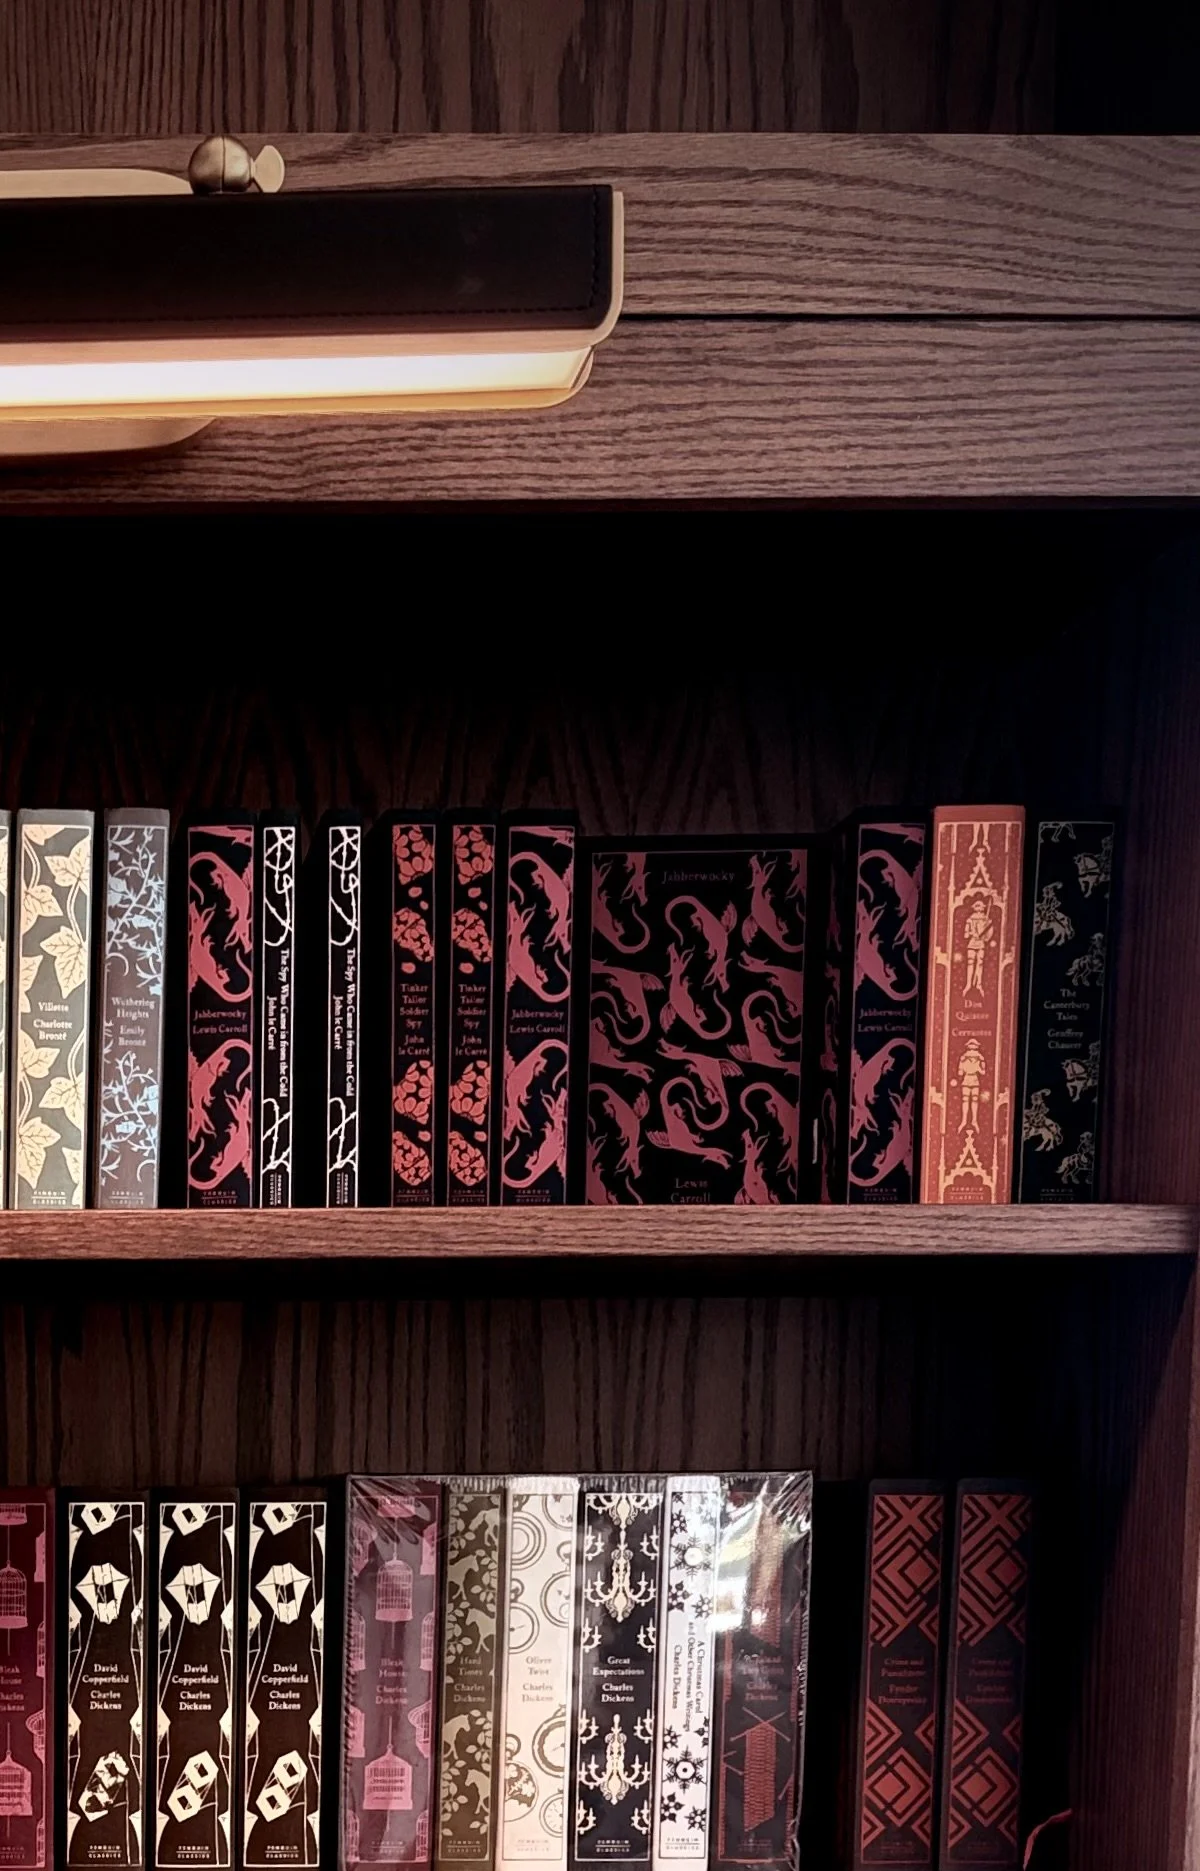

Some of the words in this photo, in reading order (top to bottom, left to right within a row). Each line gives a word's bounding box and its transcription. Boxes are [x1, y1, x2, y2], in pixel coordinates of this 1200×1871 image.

[661, 870, 735, 884] Jabberwocky
[280, 948, 290, 966] The
[278, 966, 289, 982] Spy
[280, 984, 290, 1004] Who
[38, 1002, 68, 1012] Villette
[267, 996, 277, 1016] John
[193, 1009, 246, 1020] Jabberwocky
[400, 1007, 429, 1016] Soldier
[280, 1006, 289, 1030] Came
[33, 1019, 73, 1029] Charlotte
[193, 1025, 216, 1034] Lewis
[219, 1024, 248, 1034] Carroll
[407, 1019, 422, 1029] Spy
[405, 1035, 424, 1045] John
[280, 1040, 289, 1060] from
[280, 1061, 288, 1076] the
[280, 1076, 288, 1098] Cold
[675, 1177, 708, 1189] Lewis
[671, 1191, 710, 1202] Carroll
[608, 1656, 630, 1665] Great
[94, 1664, 118, 1672] David
[273, 1664, 297, 1672] David
[592, 1667, 644, 1677] Expectations
[82, 1675, 129, 1684] Copperfield
[262, 1675, 308, 1684] Copperfield
[602, 1683, 633, 1691] Charles
[91, 1690, 120, 1699] Charles
[270, 1690, 300, 1699] Charles
[601, 1694, 634, 1703] Dickens
[90, 1701, 121, 1710] Dickens
[269, 1701, 300, 1710] Dickens
